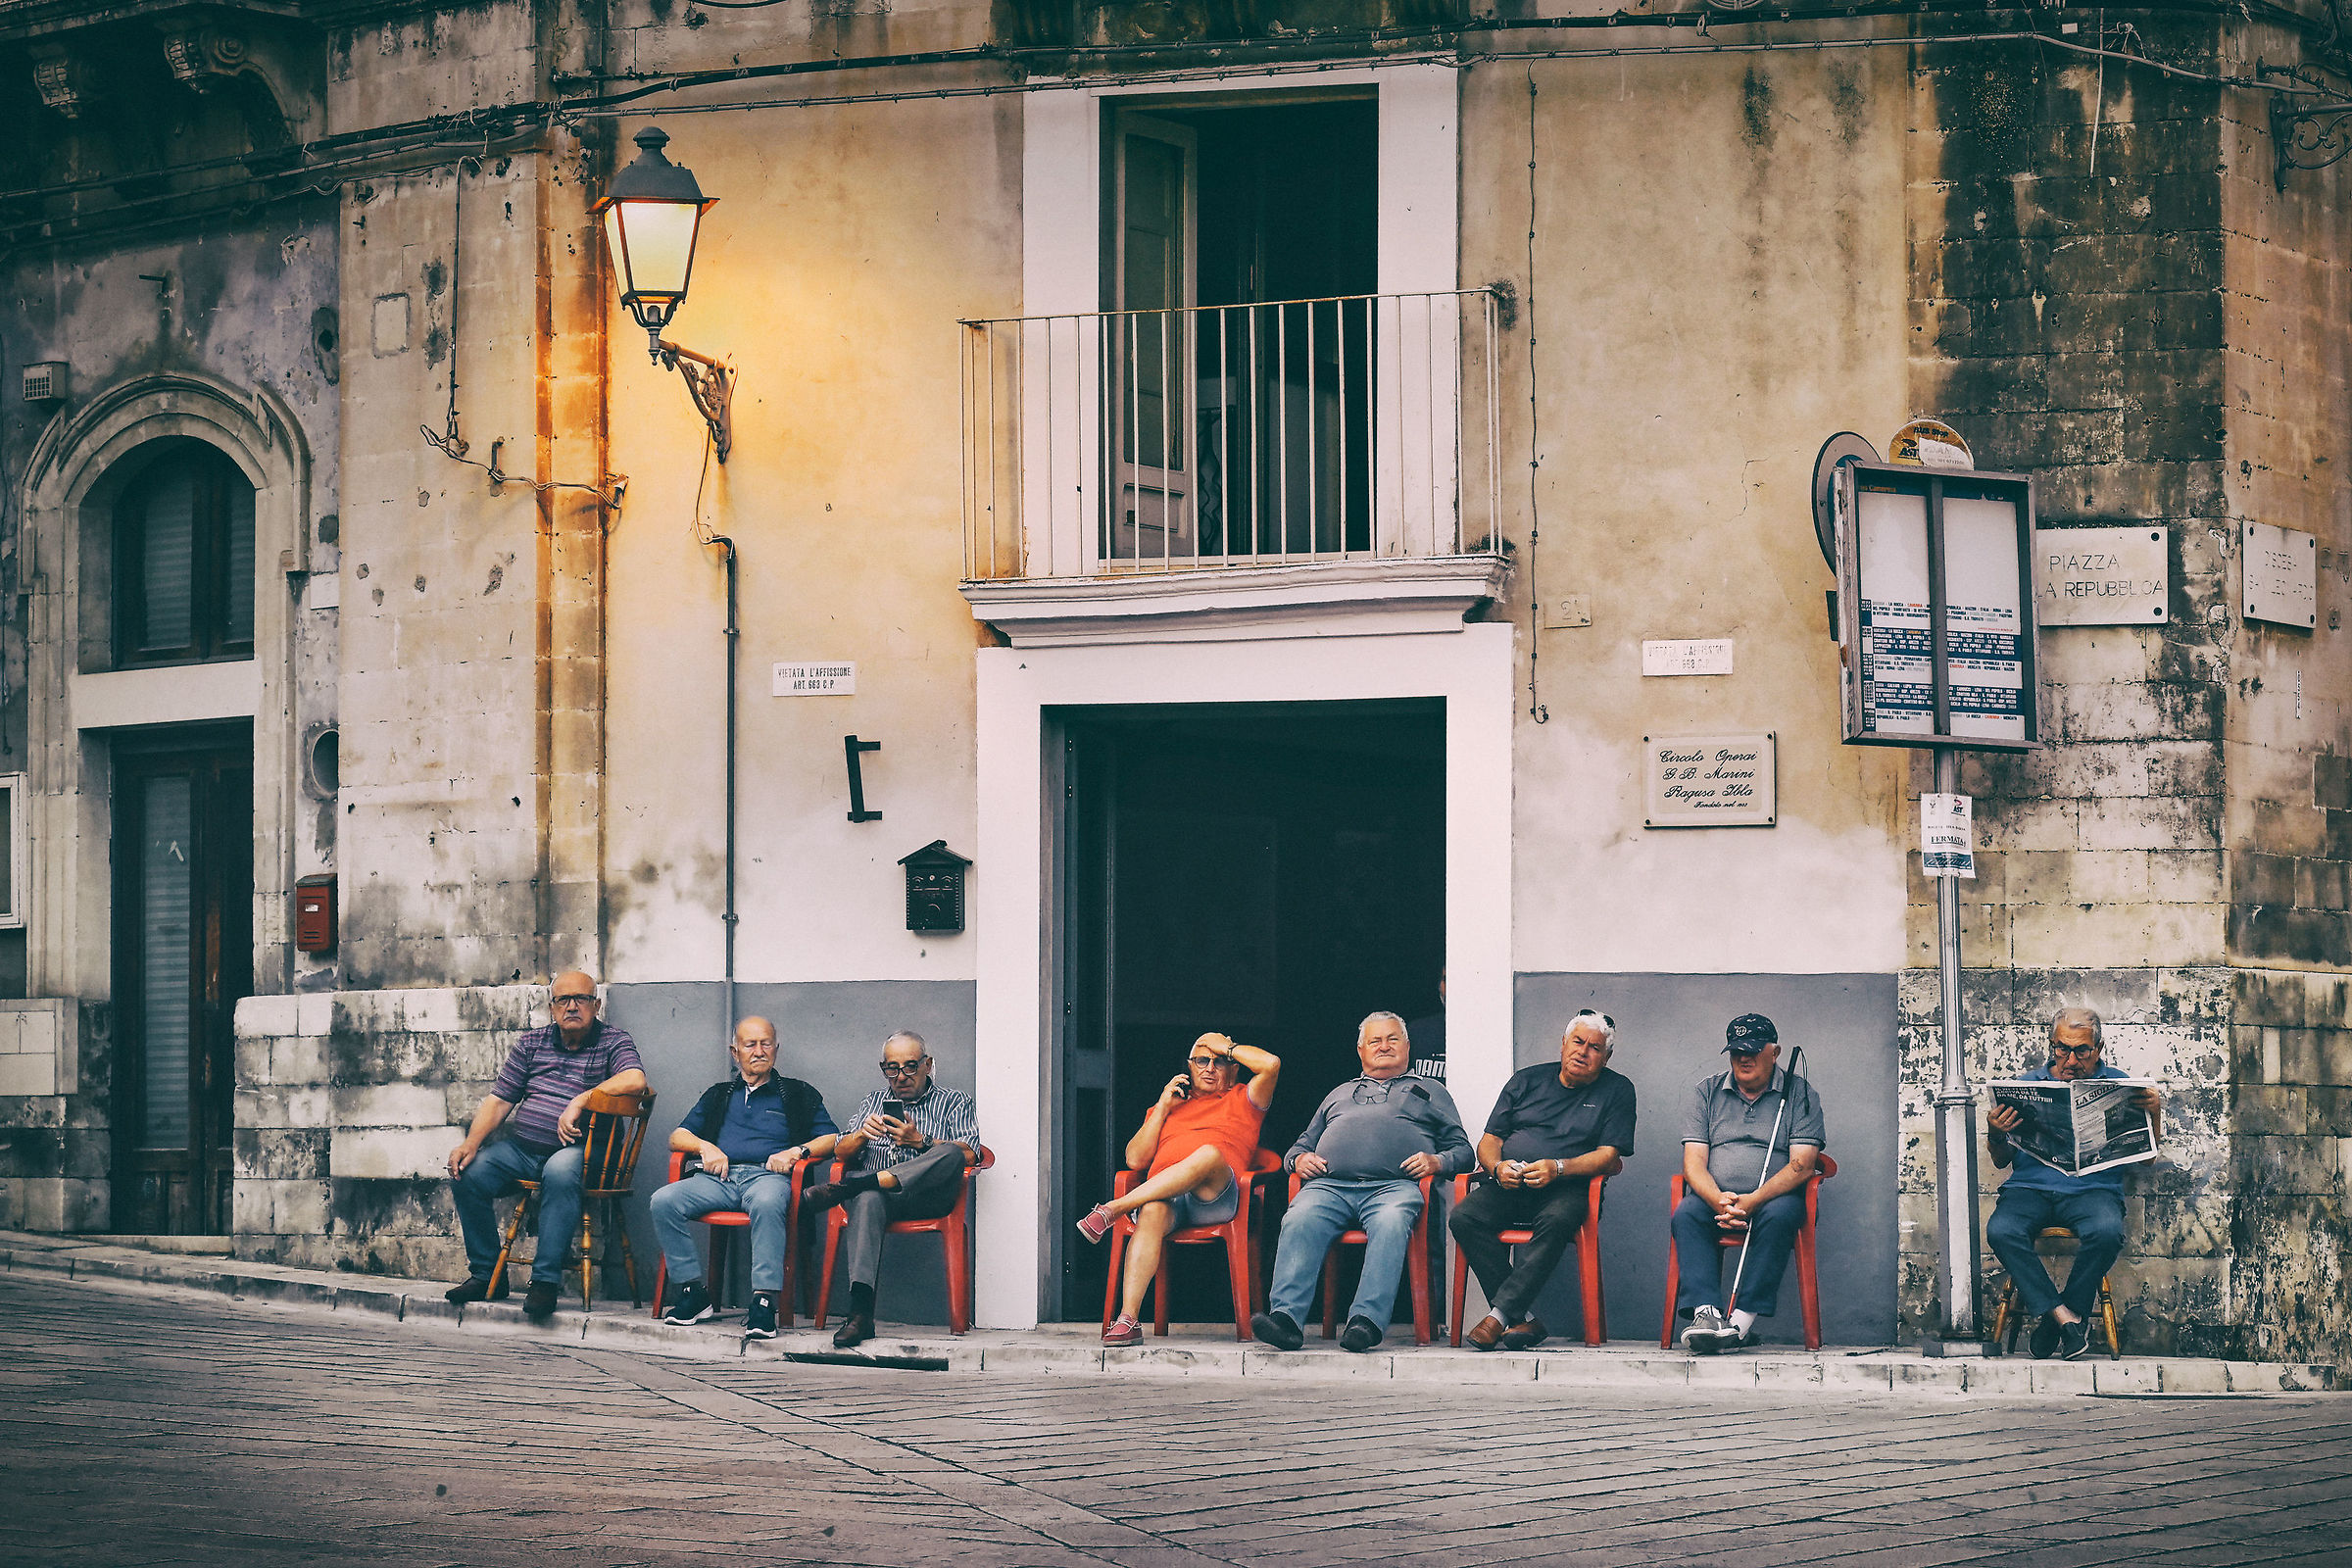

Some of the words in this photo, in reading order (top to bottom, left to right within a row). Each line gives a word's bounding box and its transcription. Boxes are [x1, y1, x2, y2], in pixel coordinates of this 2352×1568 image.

[2049, 554, 2120, 571] PIAZZA
[2064, 580, 2164, 597] REPUBBLCA
[778, 668, 805, 678] VIETATA
[810, 667, 851, 677] L'AFFISSIONE
[1659, 750, 1704, 763] Circolo
[1715, 749, 1758, 766] Operai
[1704, 767, 1756, 779] Marini
[1664, 785, 1715, 803] Ragusa
[1722, 784, 1754, 796] Ibla
[2075, 1097, 2088, 1105] LA
